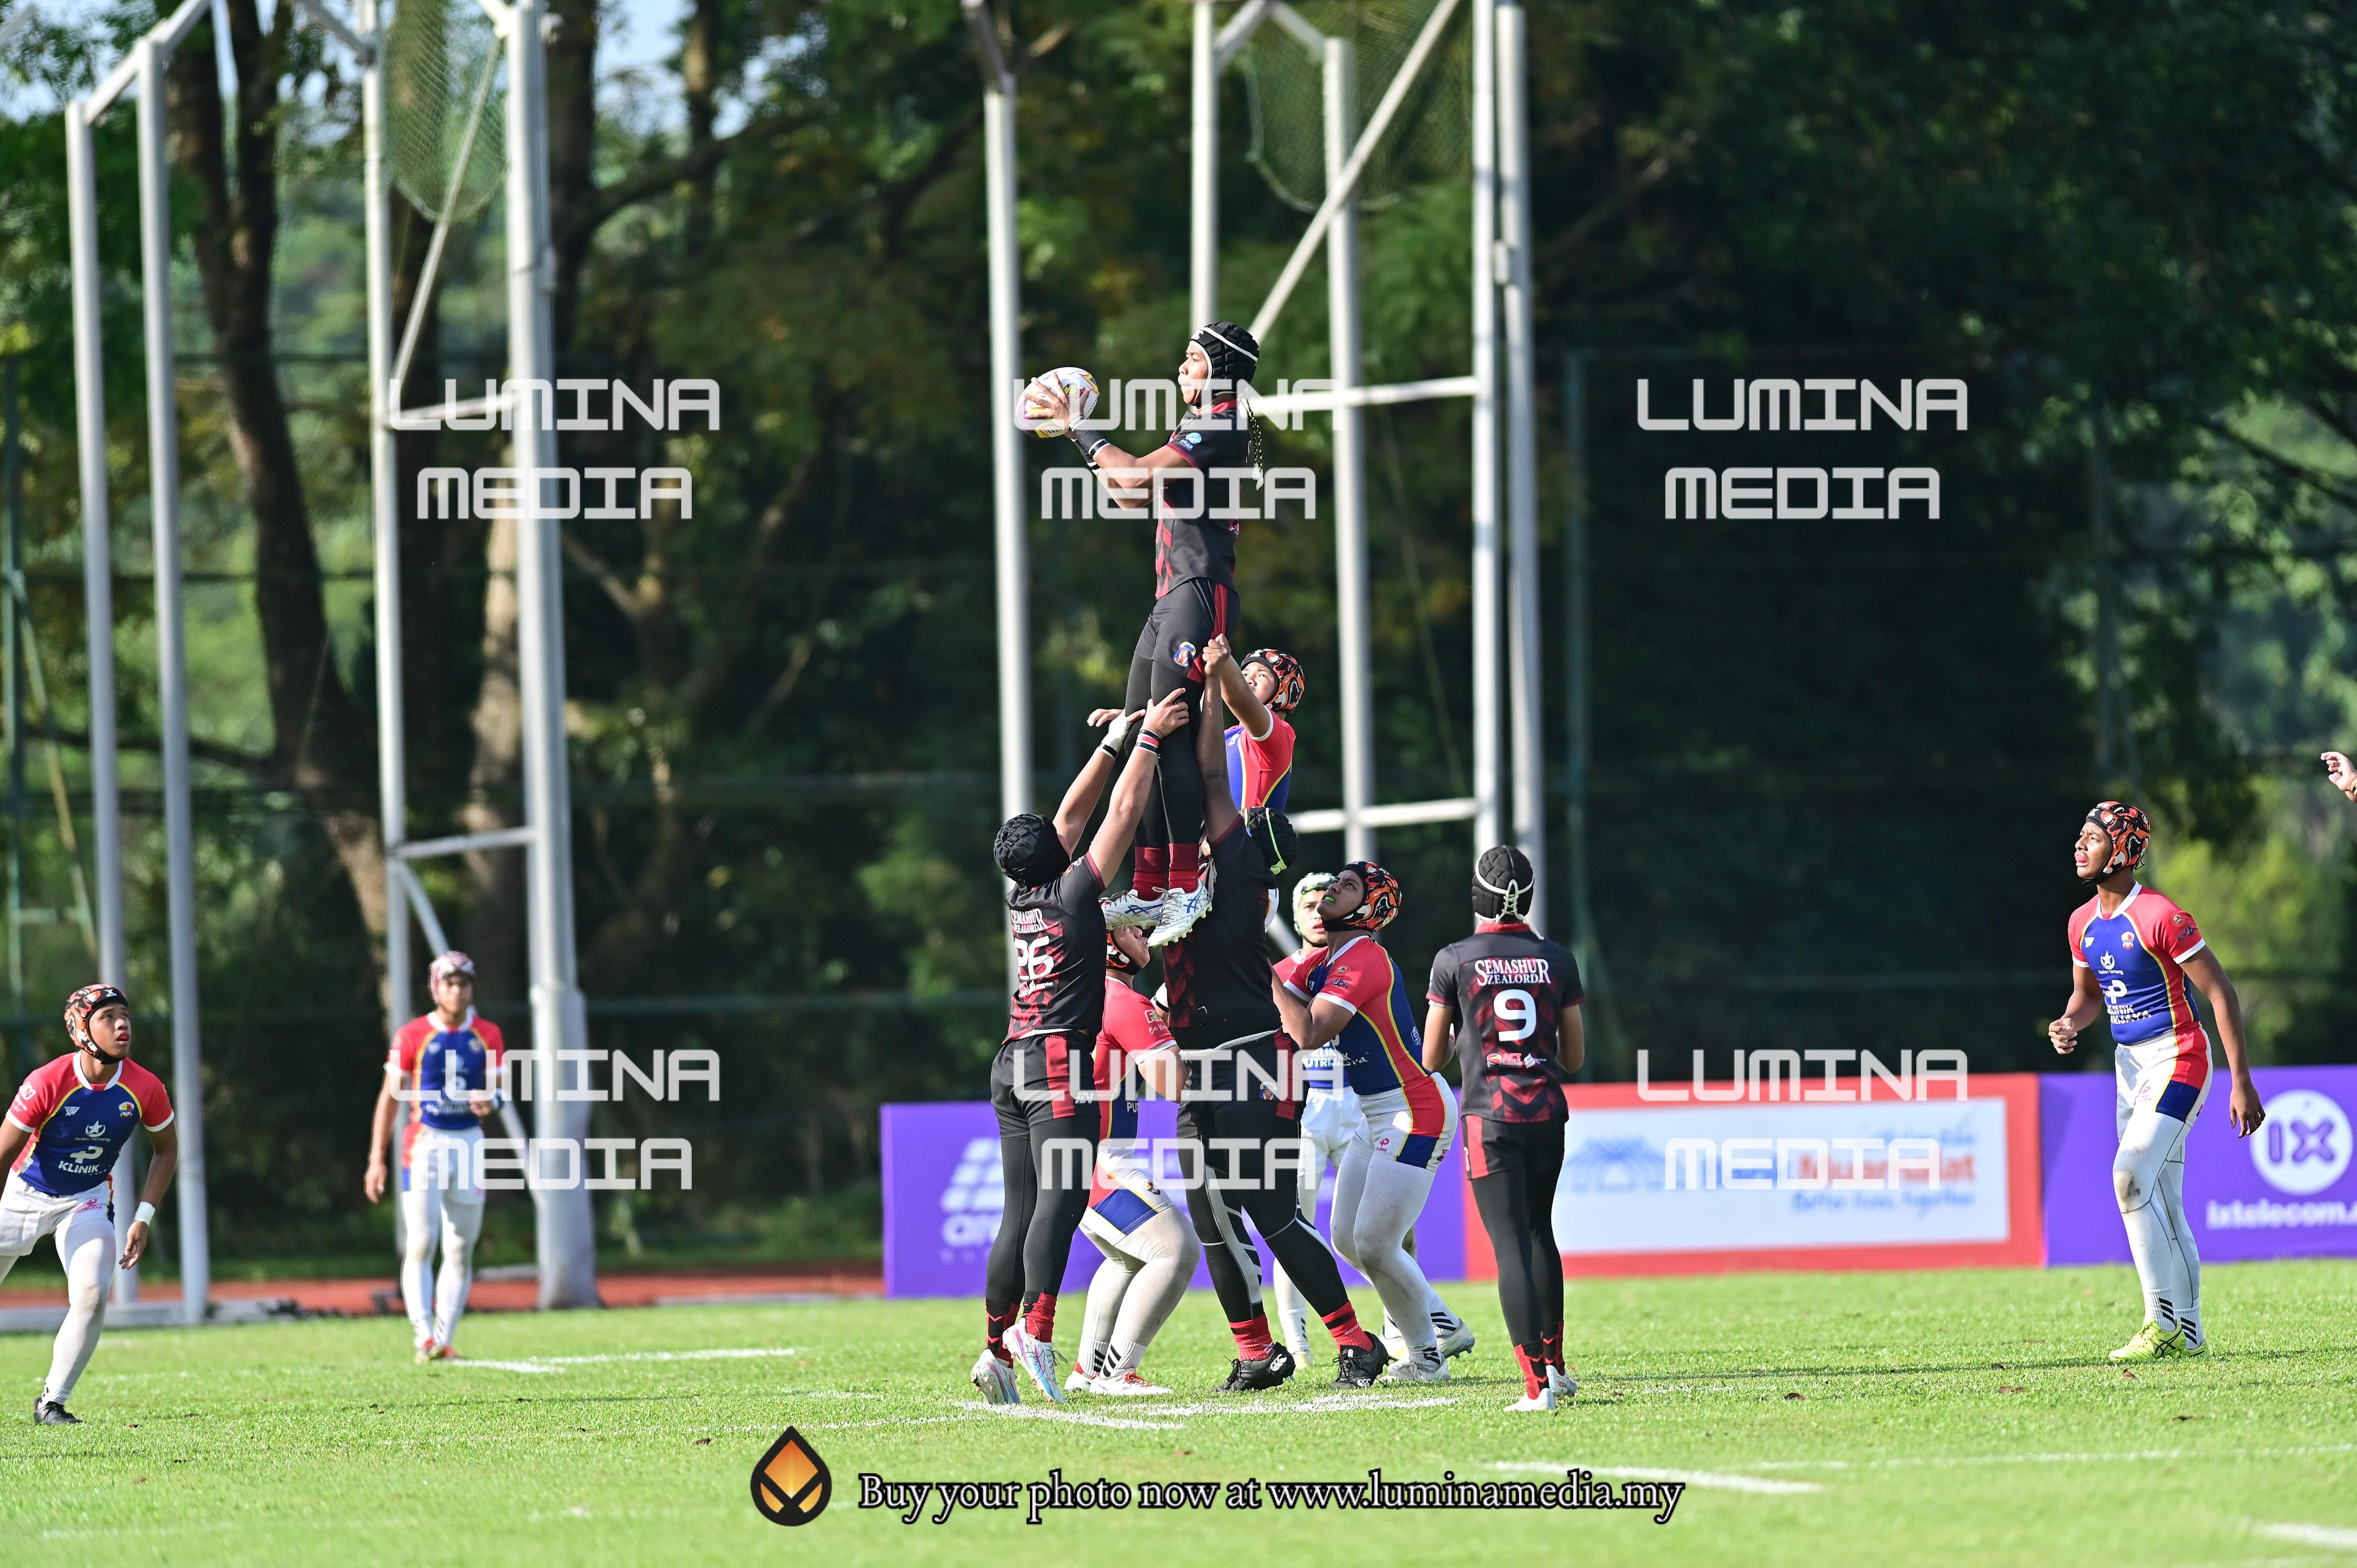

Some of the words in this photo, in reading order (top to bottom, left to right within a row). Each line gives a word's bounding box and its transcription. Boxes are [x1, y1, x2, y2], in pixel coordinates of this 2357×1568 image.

[1014, 936, 1054, 980] 26
[1475, 959, 1551, 986] SEMASHUR
[1487, 974, 1540, 985] ZEALORD
[1493, 989, 1537, 1042] 9
[1502, 1053, 1521, 1062] ACT
[2269, 1121, 2334, 1163] IX
[58, 1160, 100, 1174] KLINIK
